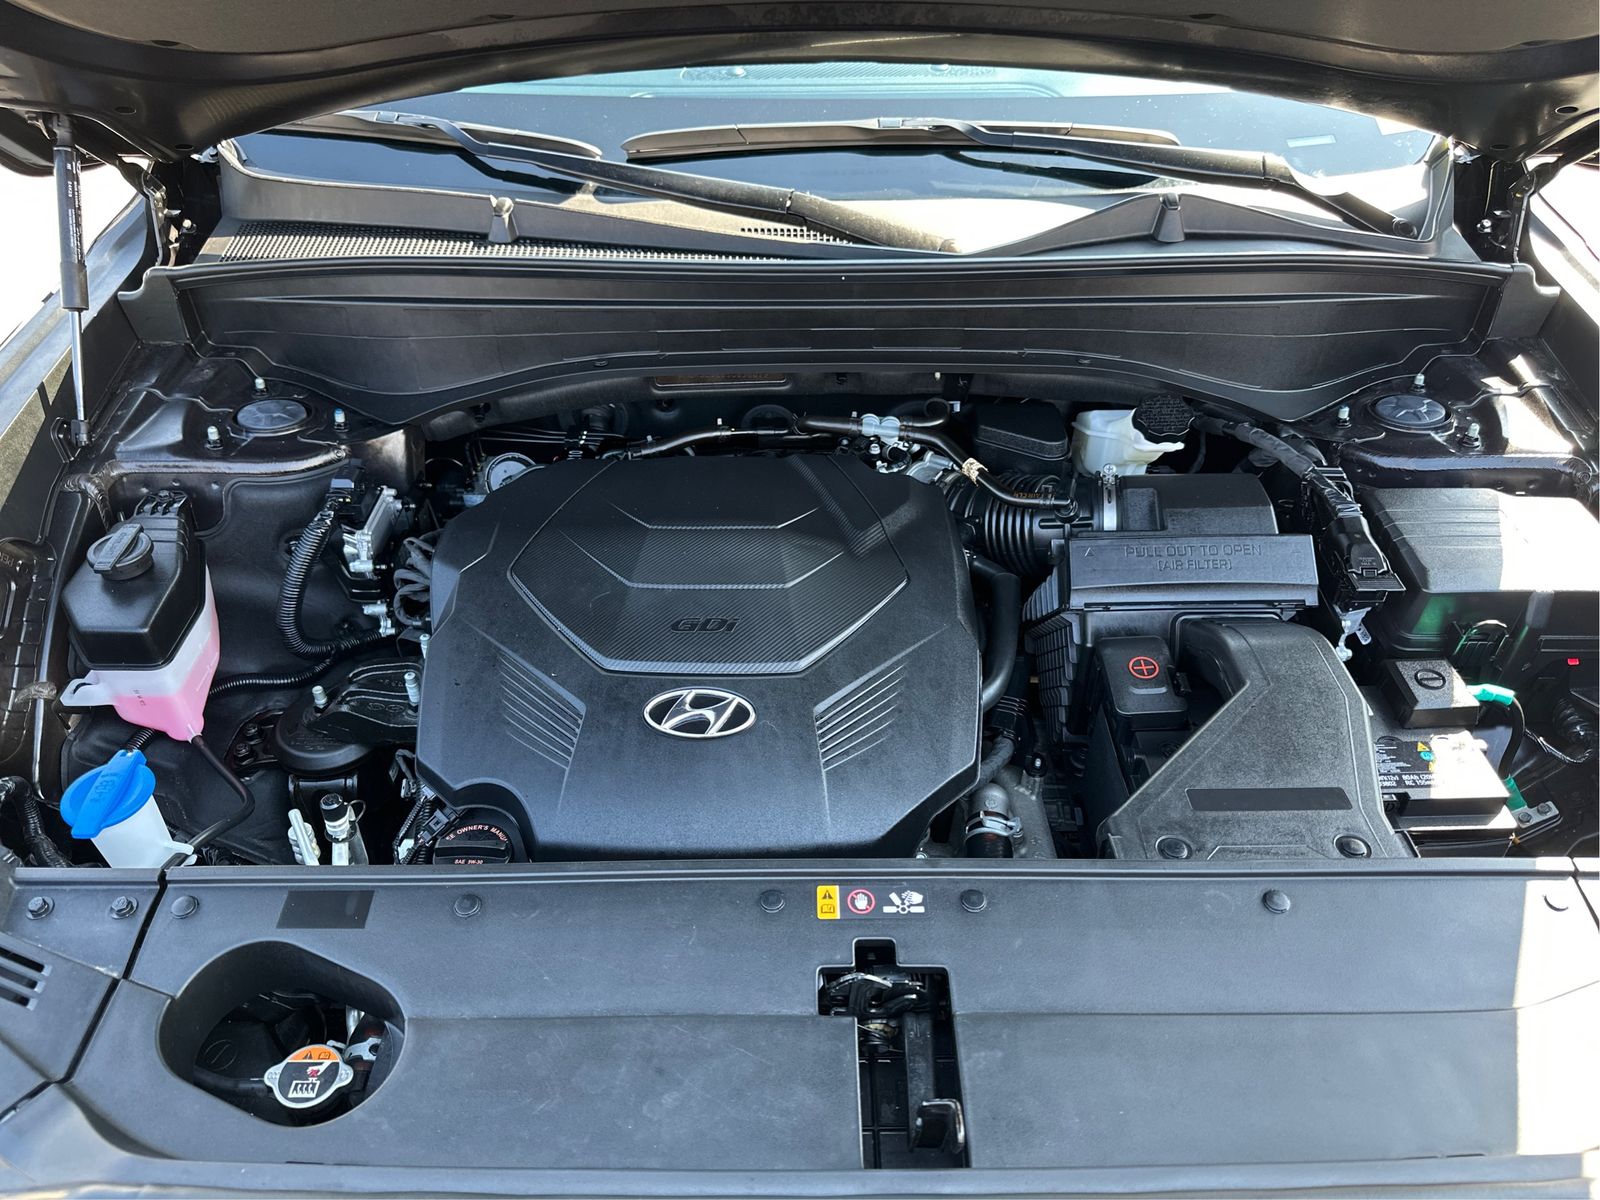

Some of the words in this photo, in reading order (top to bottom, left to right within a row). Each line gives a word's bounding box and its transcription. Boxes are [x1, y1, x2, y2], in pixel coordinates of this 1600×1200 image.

[1124, 545, 1162, 558] PULL
[1166, 545, 1195, 557] OUT
[1199, 544, 1219, 556] TO
[1222, 543, 1262, 556] OPEN
[456, 824, 489, 835] OWNER'S
